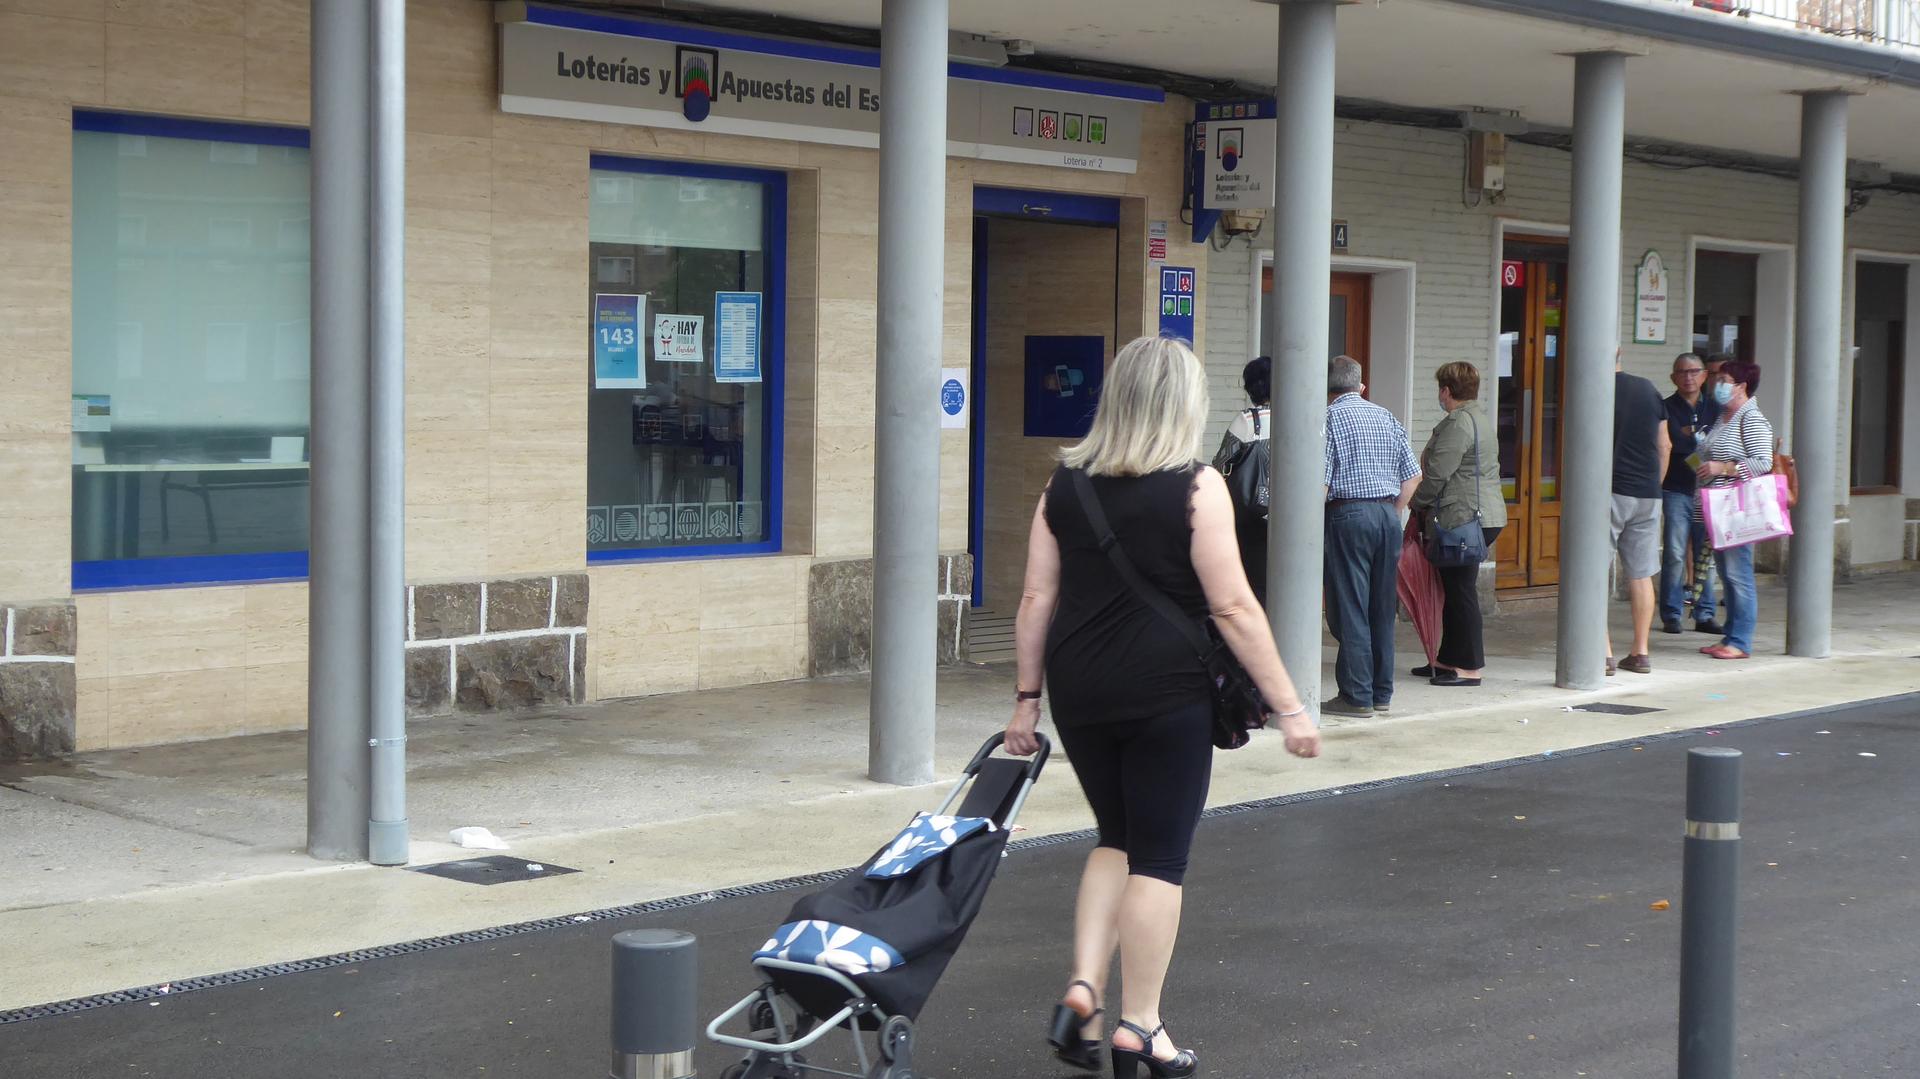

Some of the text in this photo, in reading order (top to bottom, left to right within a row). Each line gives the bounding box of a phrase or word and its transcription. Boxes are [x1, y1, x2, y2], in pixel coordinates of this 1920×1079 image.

[558, 51, 650, 86] Loterías
[659, 69, 671, 95] y
[720, 70, 815, 104] Apuestas
[822, 82, 851, 109] del
[1337, 227, 1345, 245] 4
[600, 327, 634, 345] 143
[677, 321, 698, 335] HAY
